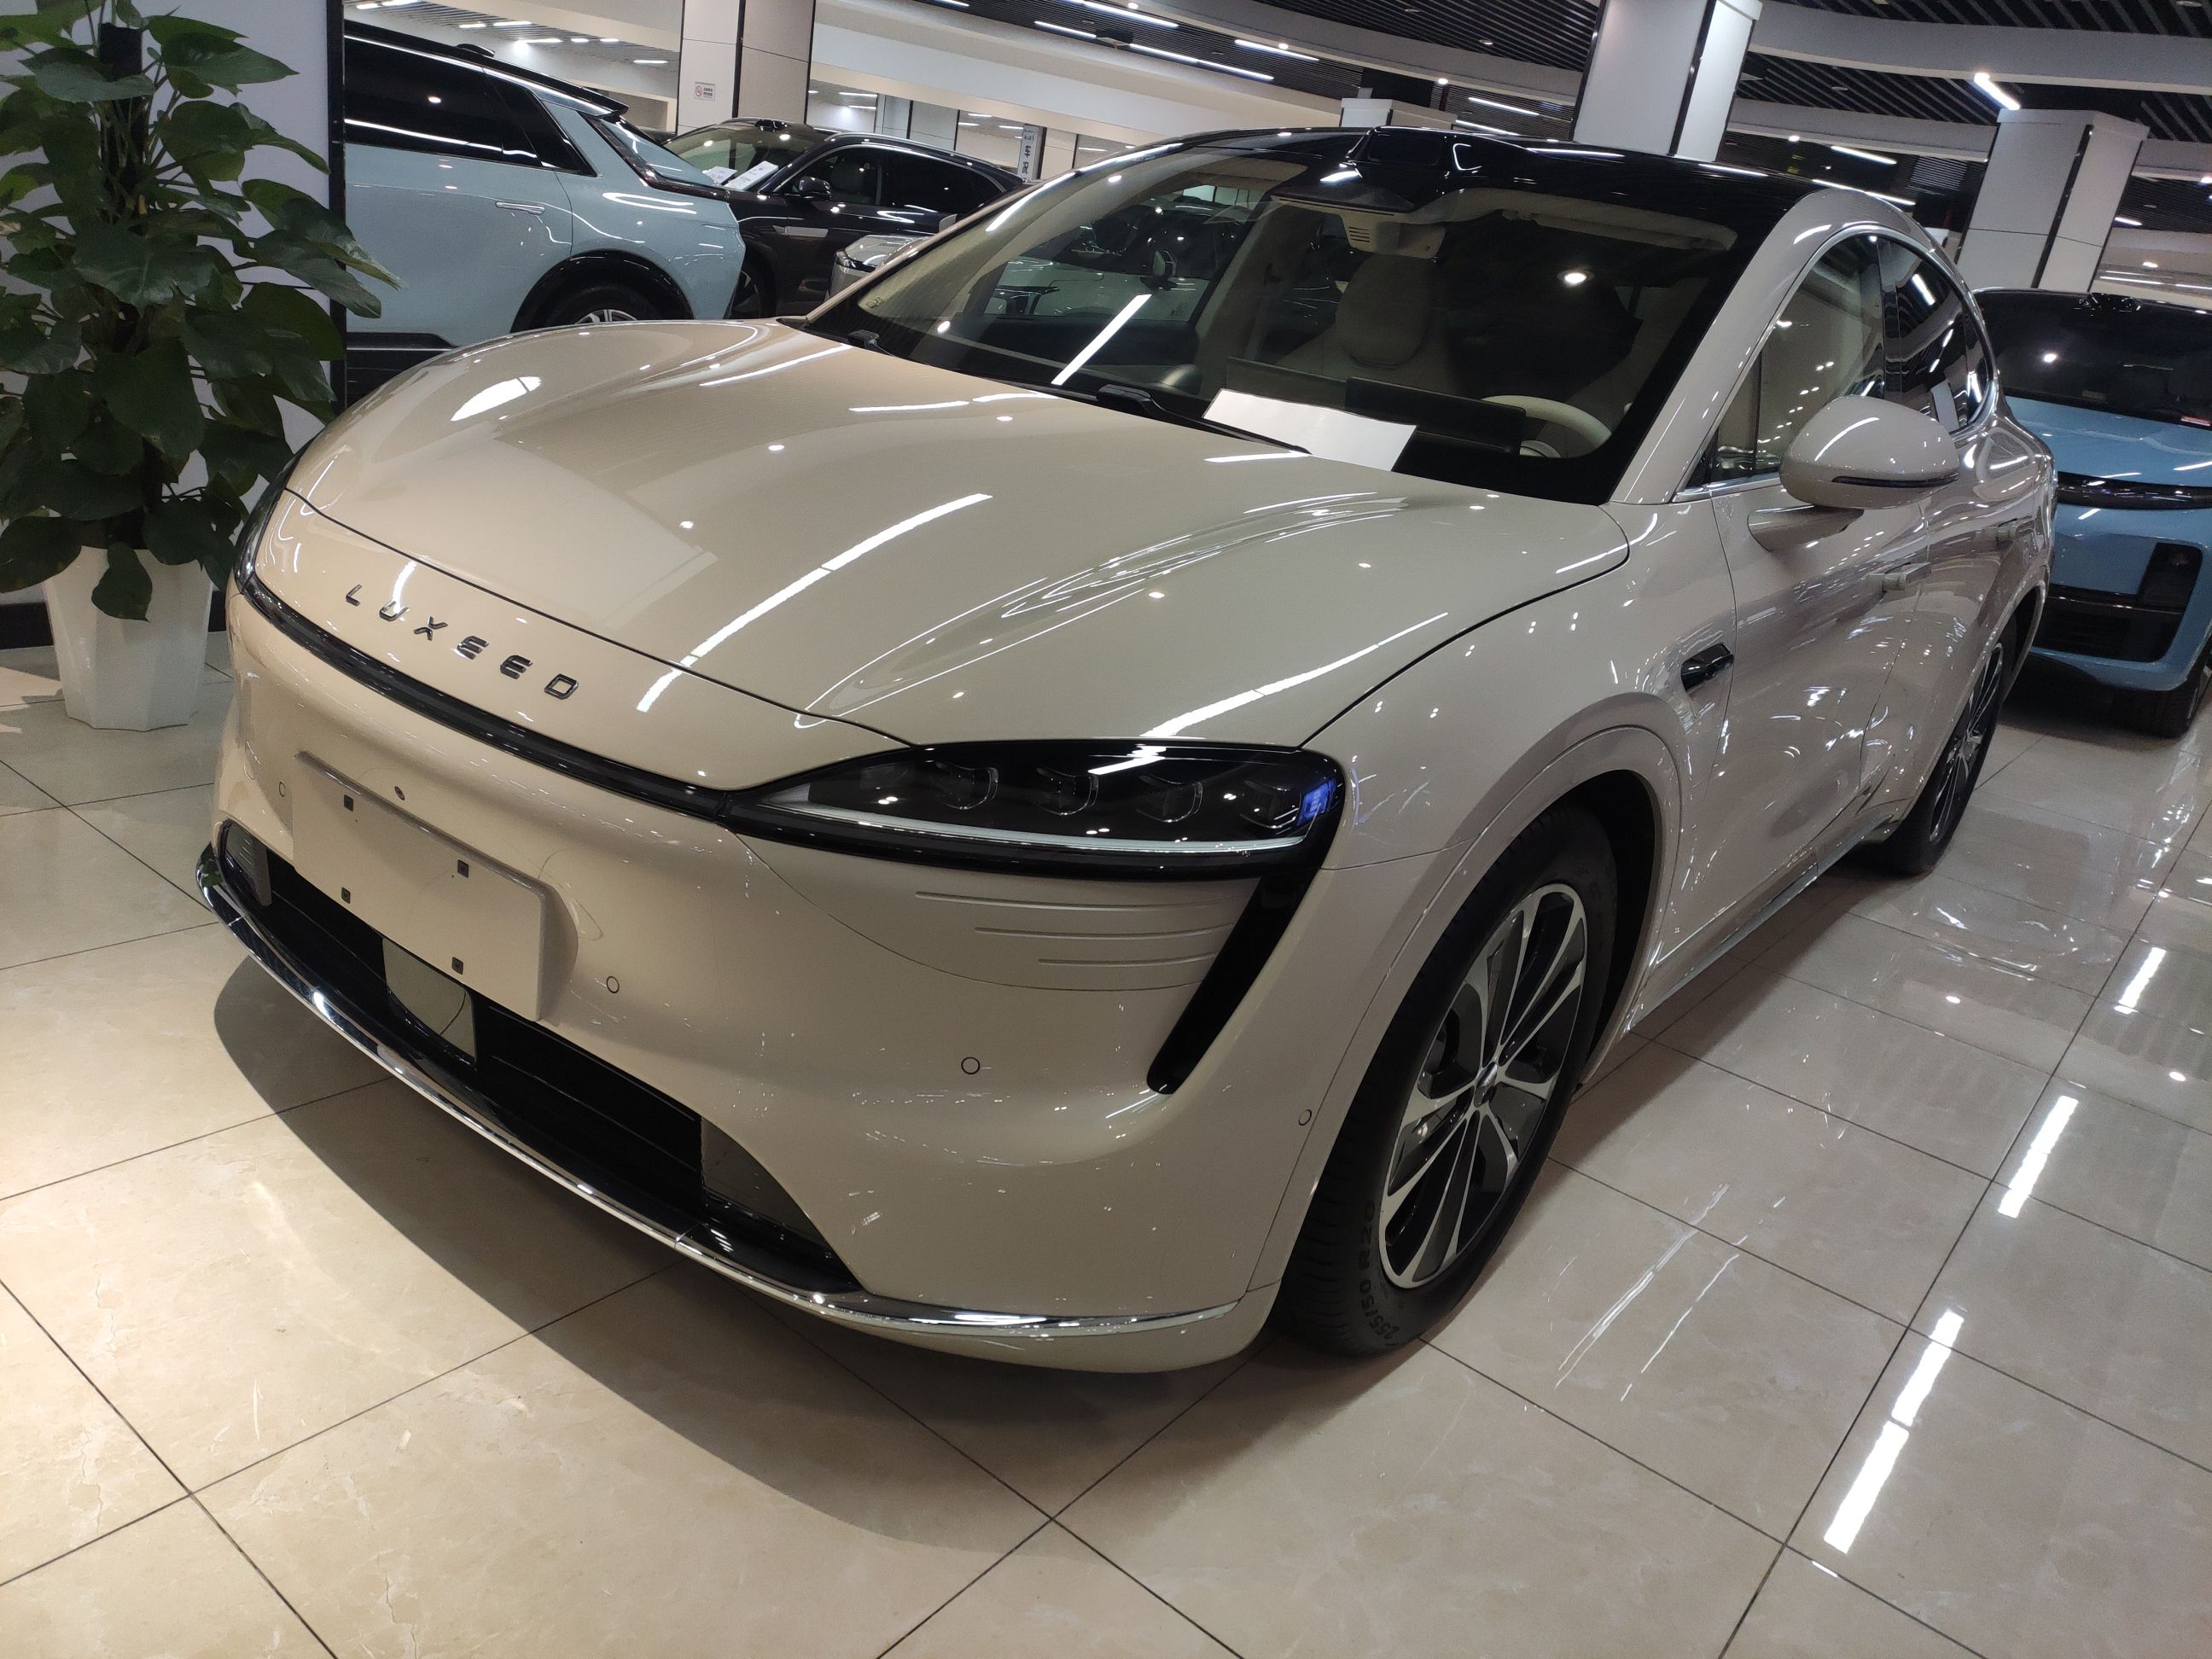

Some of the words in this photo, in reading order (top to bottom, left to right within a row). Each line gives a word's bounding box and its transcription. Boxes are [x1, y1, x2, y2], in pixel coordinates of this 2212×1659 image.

[345, 584, 579, 700] LUXEED
[1359, 1201, 1376, 1270] R20
[1359, 1280, 1400, 1340] 255/50
